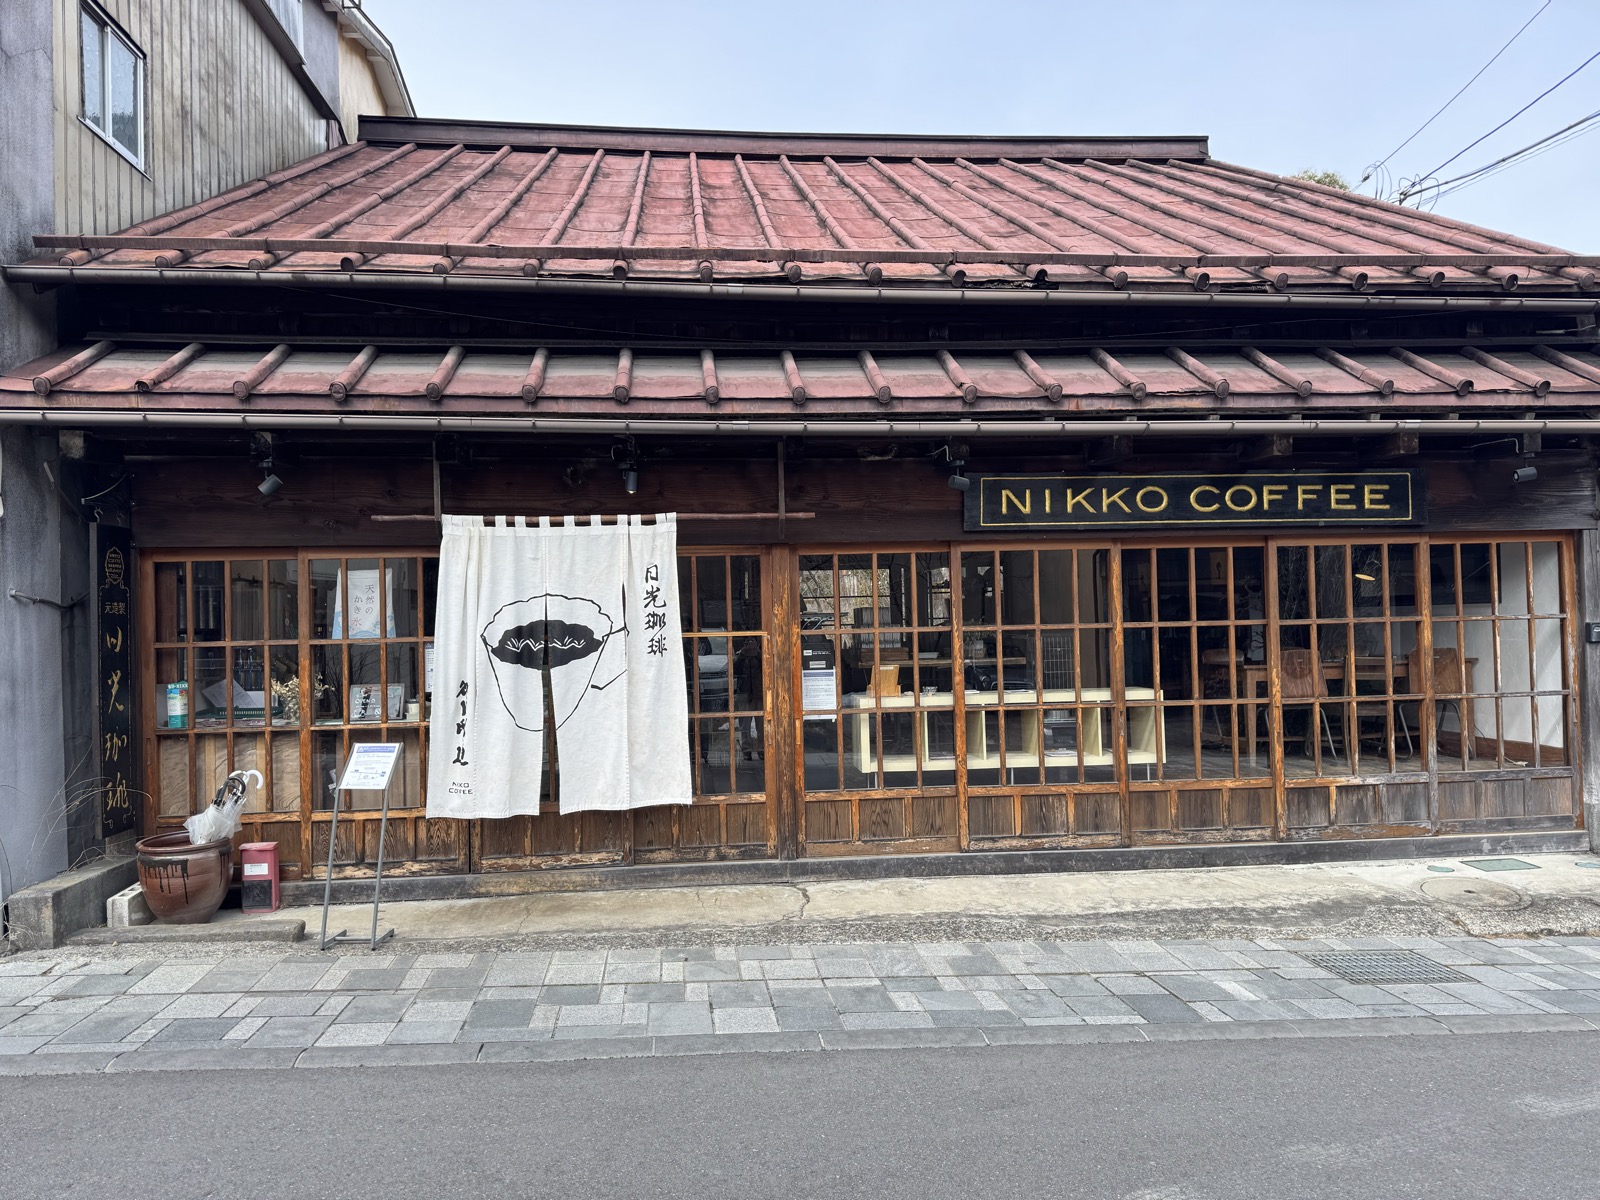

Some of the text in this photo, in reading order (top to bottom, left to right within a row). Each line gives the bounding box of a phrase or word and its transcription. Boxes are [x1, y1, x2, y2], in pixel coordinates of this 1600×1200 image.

[1000, 483, 1391, 514] NIKKO COFFEE
[352, 594, 363, 627] かき氷
[365, 584, 375, 615] 天然の
[642, 563, 667, 658] 日光珈琲
